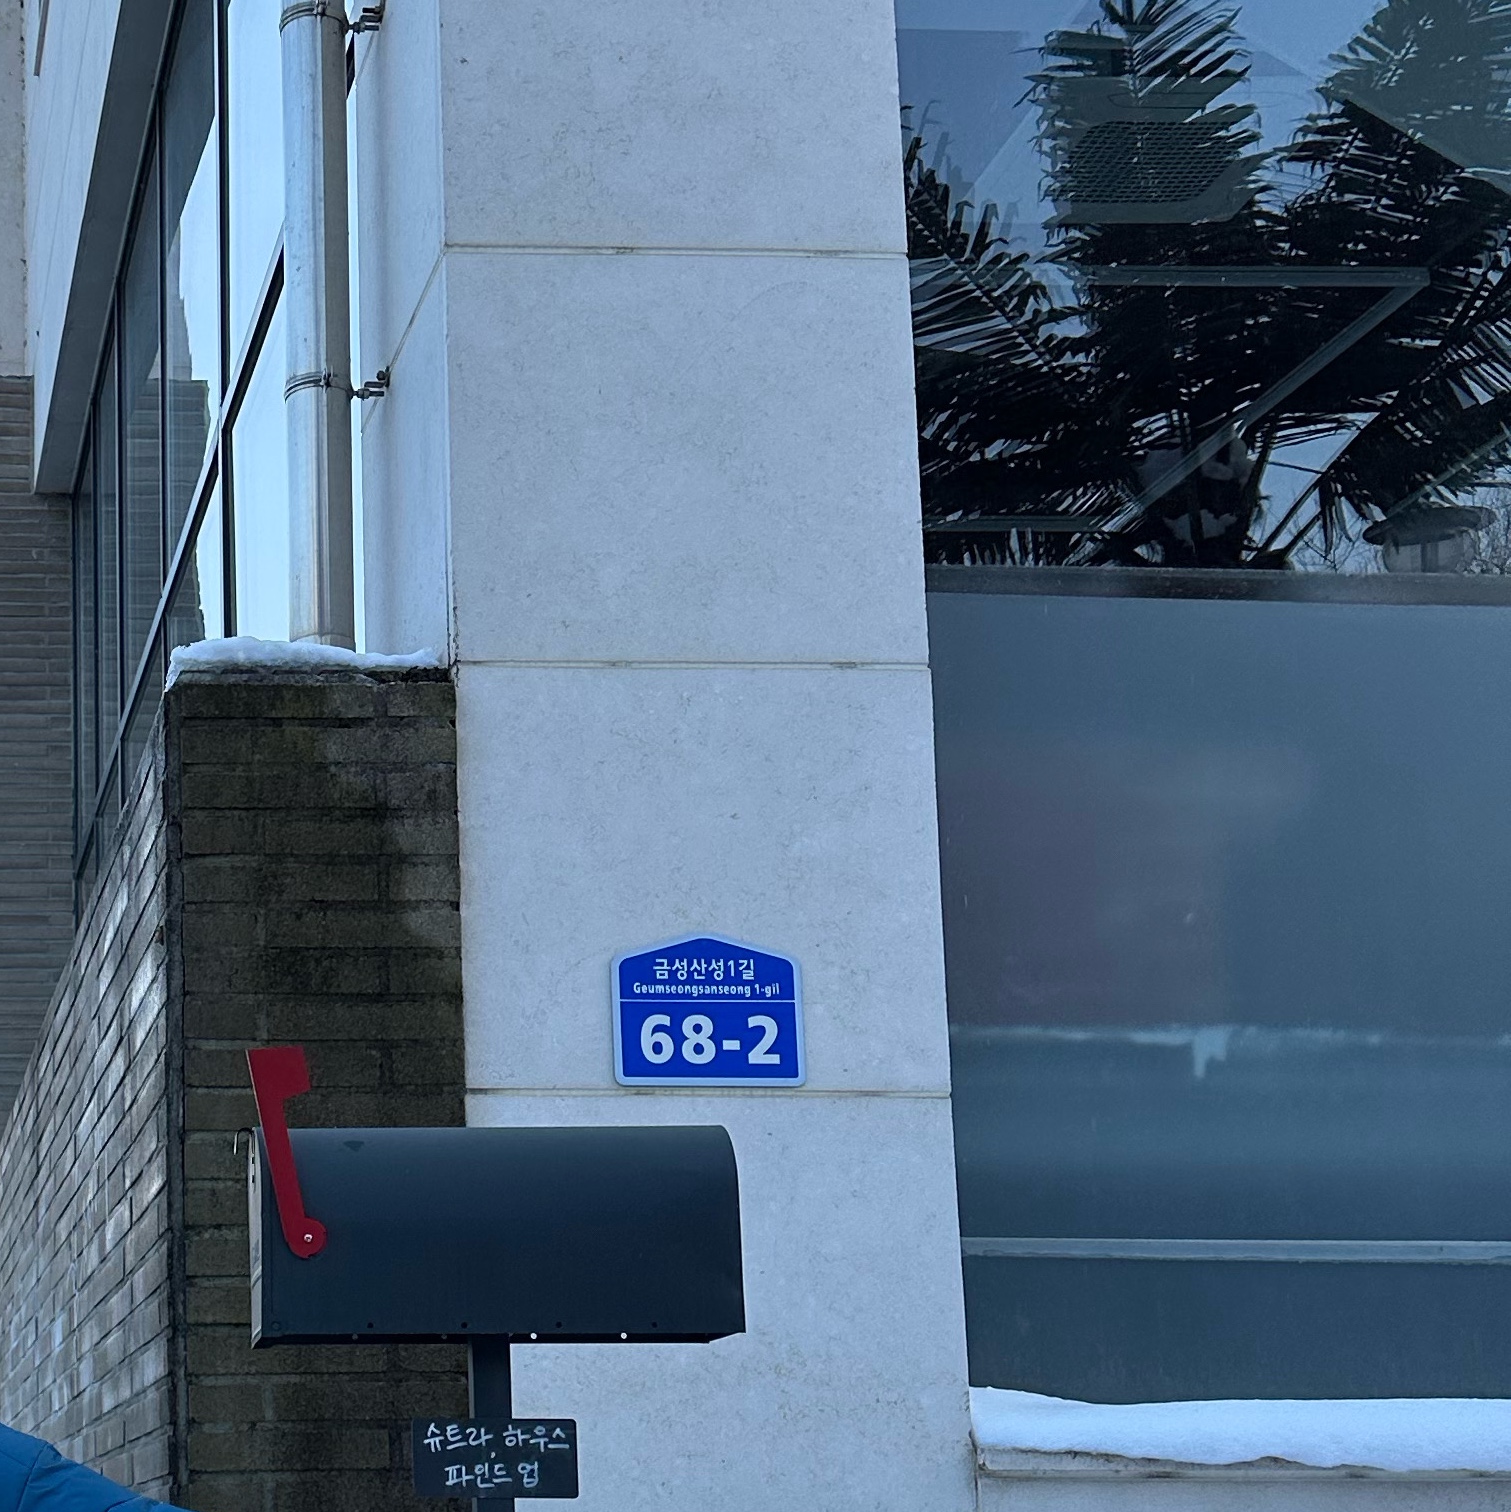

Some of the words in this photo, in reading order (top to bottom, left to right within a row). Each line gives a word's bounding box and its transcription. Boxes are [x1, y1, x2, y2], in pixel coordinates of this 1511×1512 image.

[653, 958, 755, 980] 금성산성1길
[633, 982, 751, 997] Geumseongsanseong
[754, 983, 780, 997] 1-gil
[640, 1014, 781, 1065] 68-2
[423, 1422, 494, 1452] 슈트라
[502, 1424, 570, 1452] 하우스
[444, 1462, 513, 1488] 파인드
[517, 1461, 539, 1488] 업
